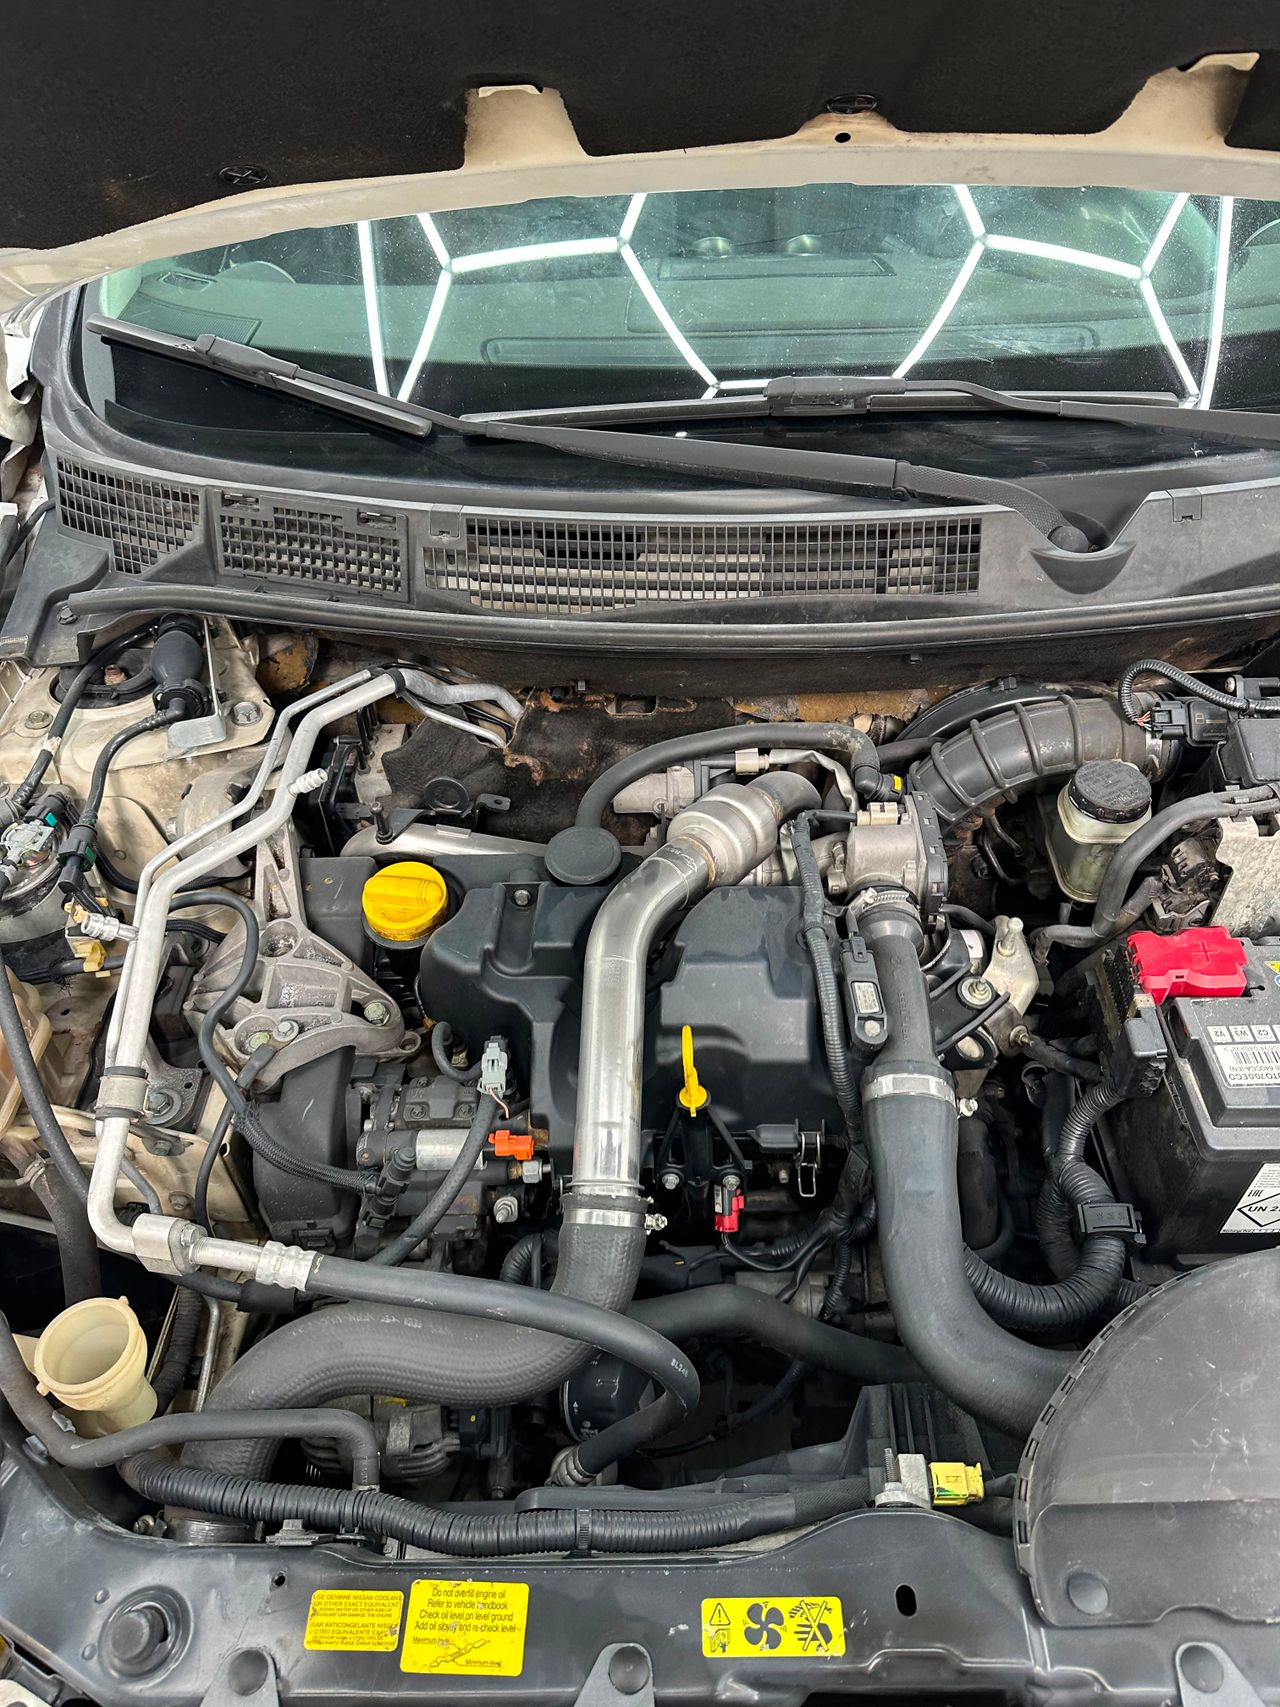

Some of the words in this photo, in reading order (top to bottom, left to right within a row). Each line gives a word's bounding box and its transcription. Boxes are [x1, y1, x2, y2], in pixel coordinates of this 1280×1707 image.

[1234, 1029, 1249, 1037] W3
[432, 1587, 442, 1597] Do
[443, 1588, 453, 1598] not
[454, 1588, 475, 1598] overfill
[475, 1590, 497, 1600] engine
[498, 1589, 506, 1599] oil
[427, 1598, 445, 1608] Refer
[446, 1599, 453, 1608] to
[453, 1600, 476, 1609] vehicle
[419, 1609, 440, 1619] Check
[449, 1610, 465, 1620] level
[465, 1613, 474, 1621] on
[475, 1611, 490, 1621] level
[490, 1612, 514, 1623] ground
[414, 1620, 428, 1630] Add
[429, 1621, 437, 1631] oil
[458, 1623, 471, 1632] and
[472, 1623, 500, 1633] re-check
[500, 1623, 516, 1633] level
